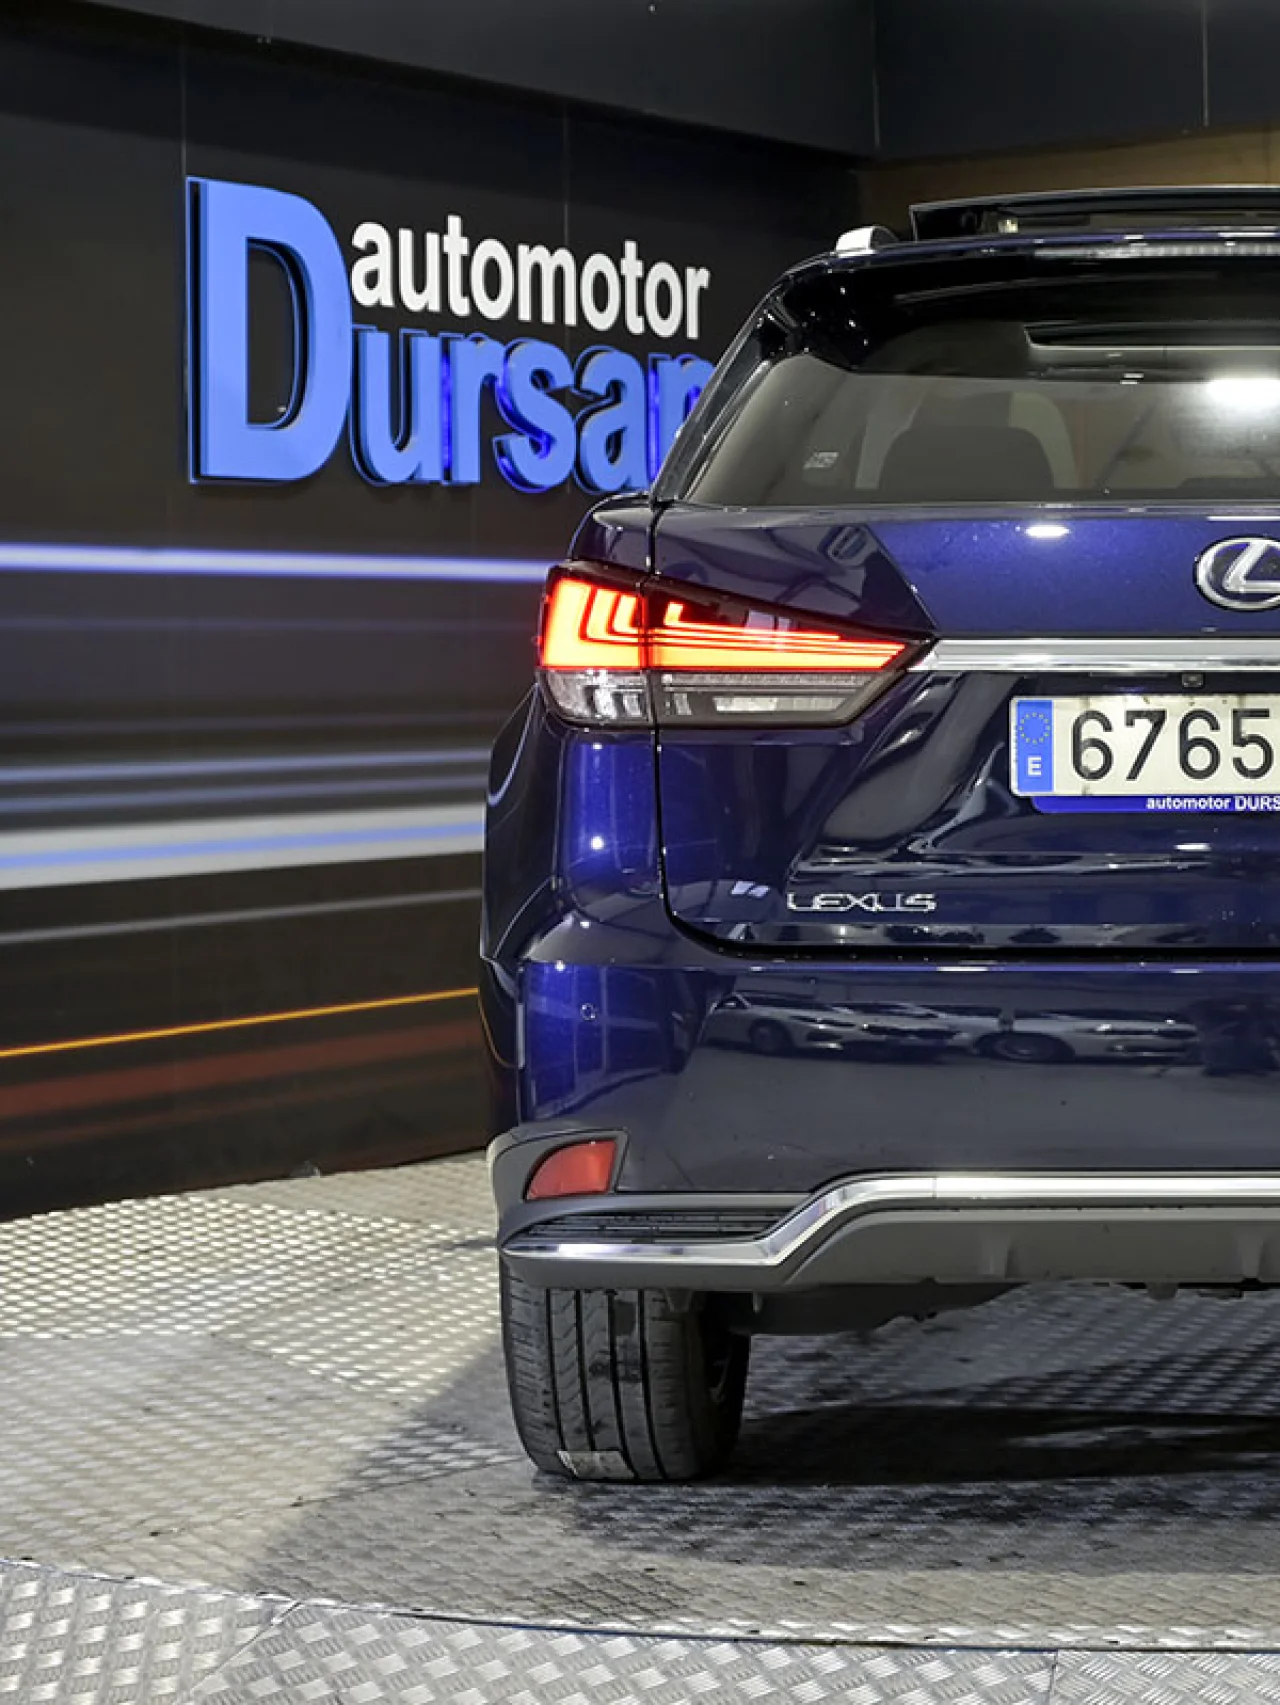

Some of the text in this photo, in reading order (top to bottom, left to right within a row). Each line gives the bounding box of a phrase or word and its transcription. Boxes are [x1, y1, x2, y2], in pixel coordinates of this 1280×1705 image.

[351, 214, 710, 339] automotor
[1071, 709, 1274, 782] 6765
[1027, 755, 1042, 776] E
[1146, 795, 1230, 810] automotor
[787, 892, 938, 912] LEXUS
